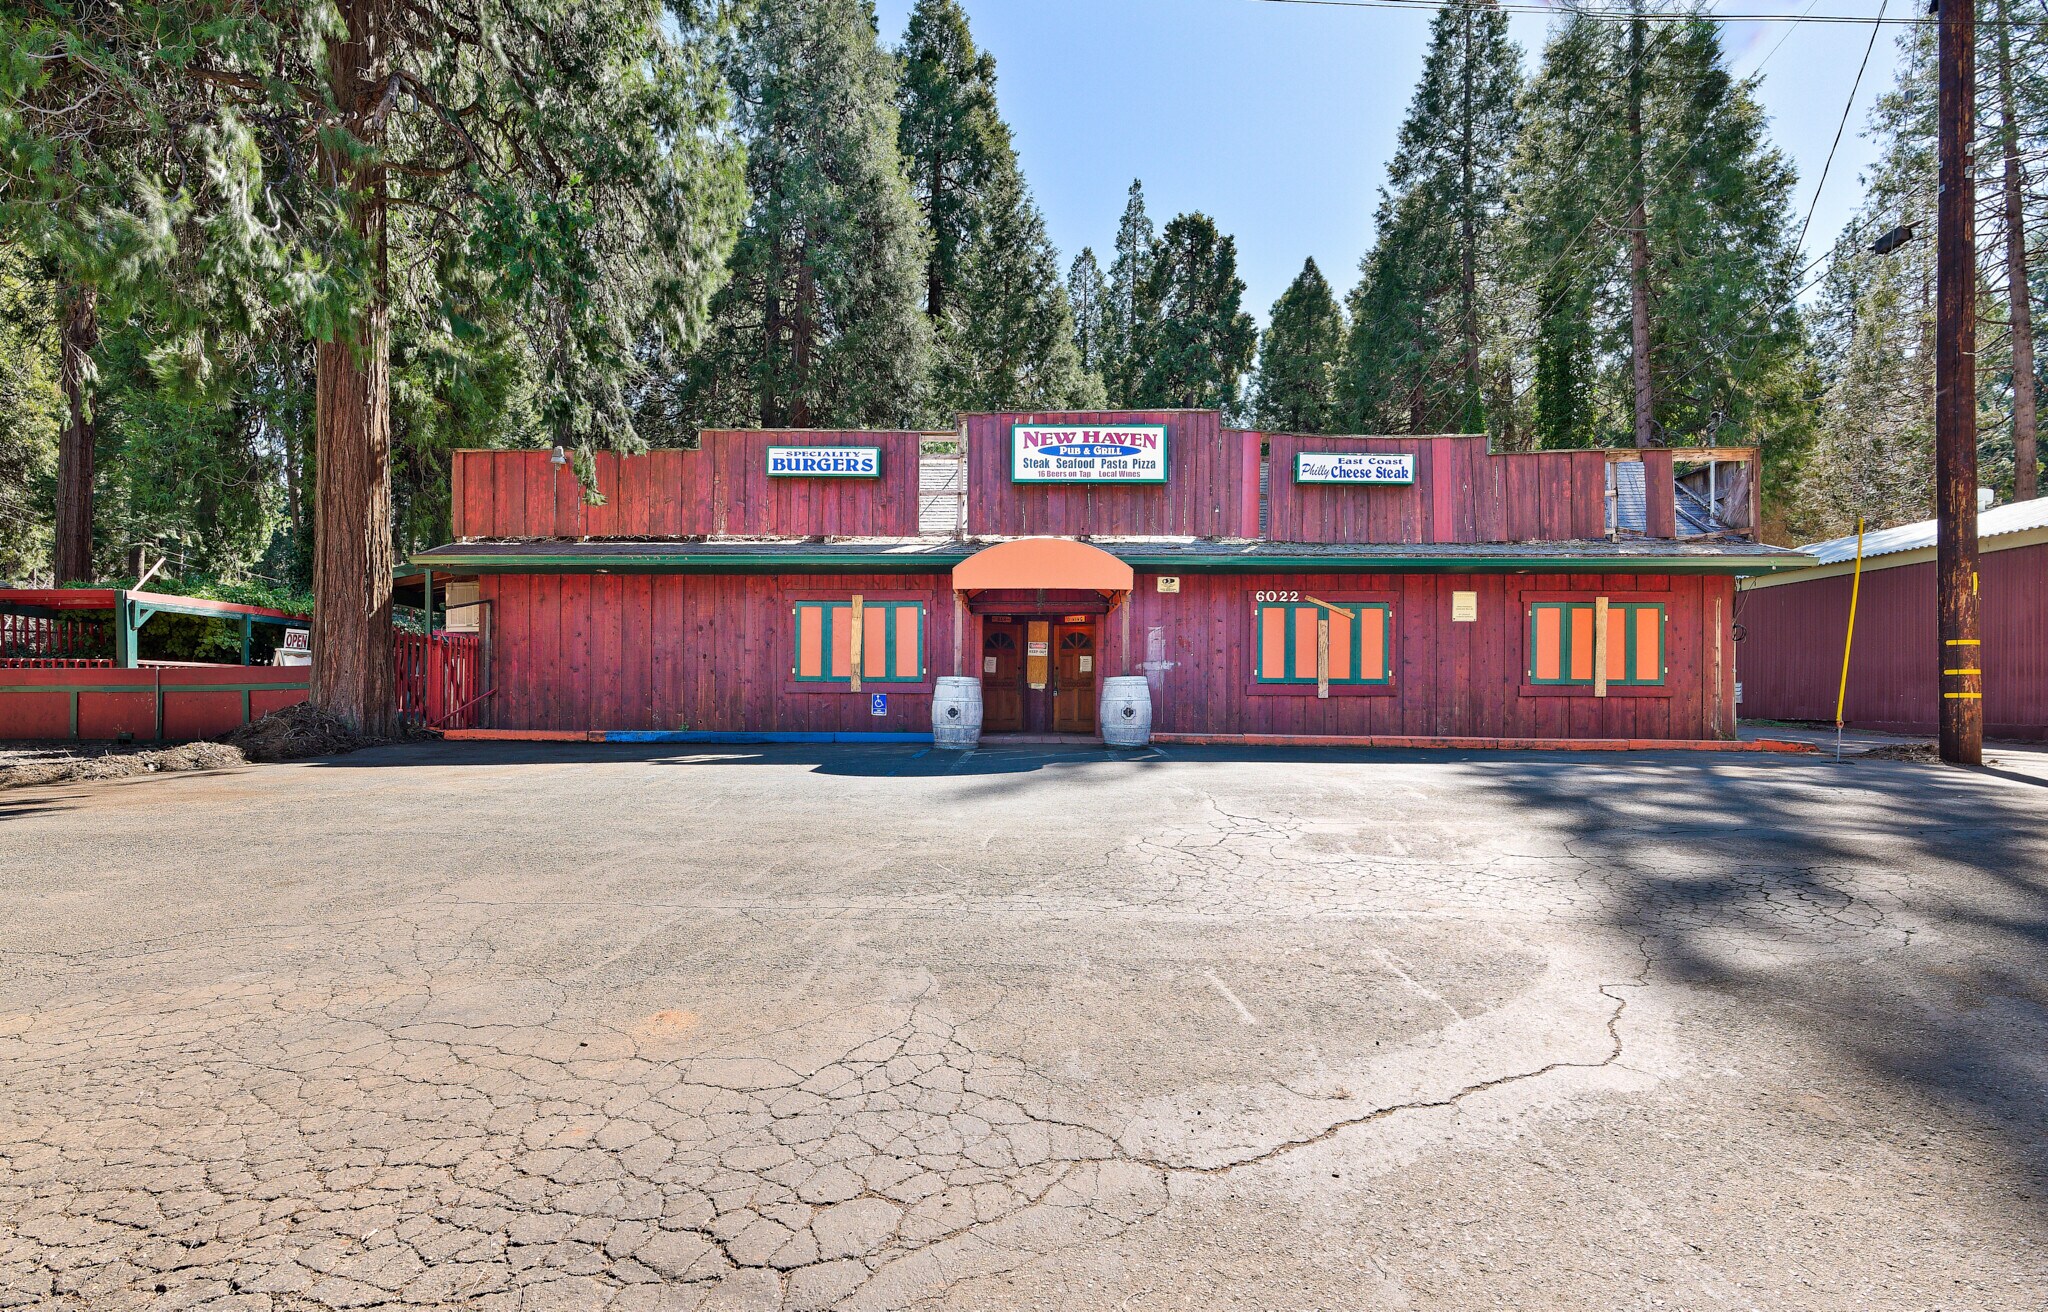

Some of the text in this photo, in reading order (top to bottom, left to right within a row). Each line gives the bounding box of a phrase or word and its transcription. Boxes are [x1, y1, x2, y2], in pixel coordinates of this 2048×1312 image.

[1023, 431, 1157, 449] NEW HAVEN
[1059, 446, 1122, 455] PUB & GRILL
[772, 458, 873, 472] BURGERS
[1023, 457, 1156, 469] Steak Seafood Pasta Pizza
[1038, 470, 1045, 478] 16
[1046, 470, 1067, 478] Beers
[1079, 470, 1091, 479] Tap
[1099, 470, 1118, 478] Local
[1118, 470, 1141, 478] Wines
[1301, 463, 1409, 479] Philly Cheese Steak
[1255, 590, 1299, 602] 6022
[285, 634, 307, 648] OPEN
